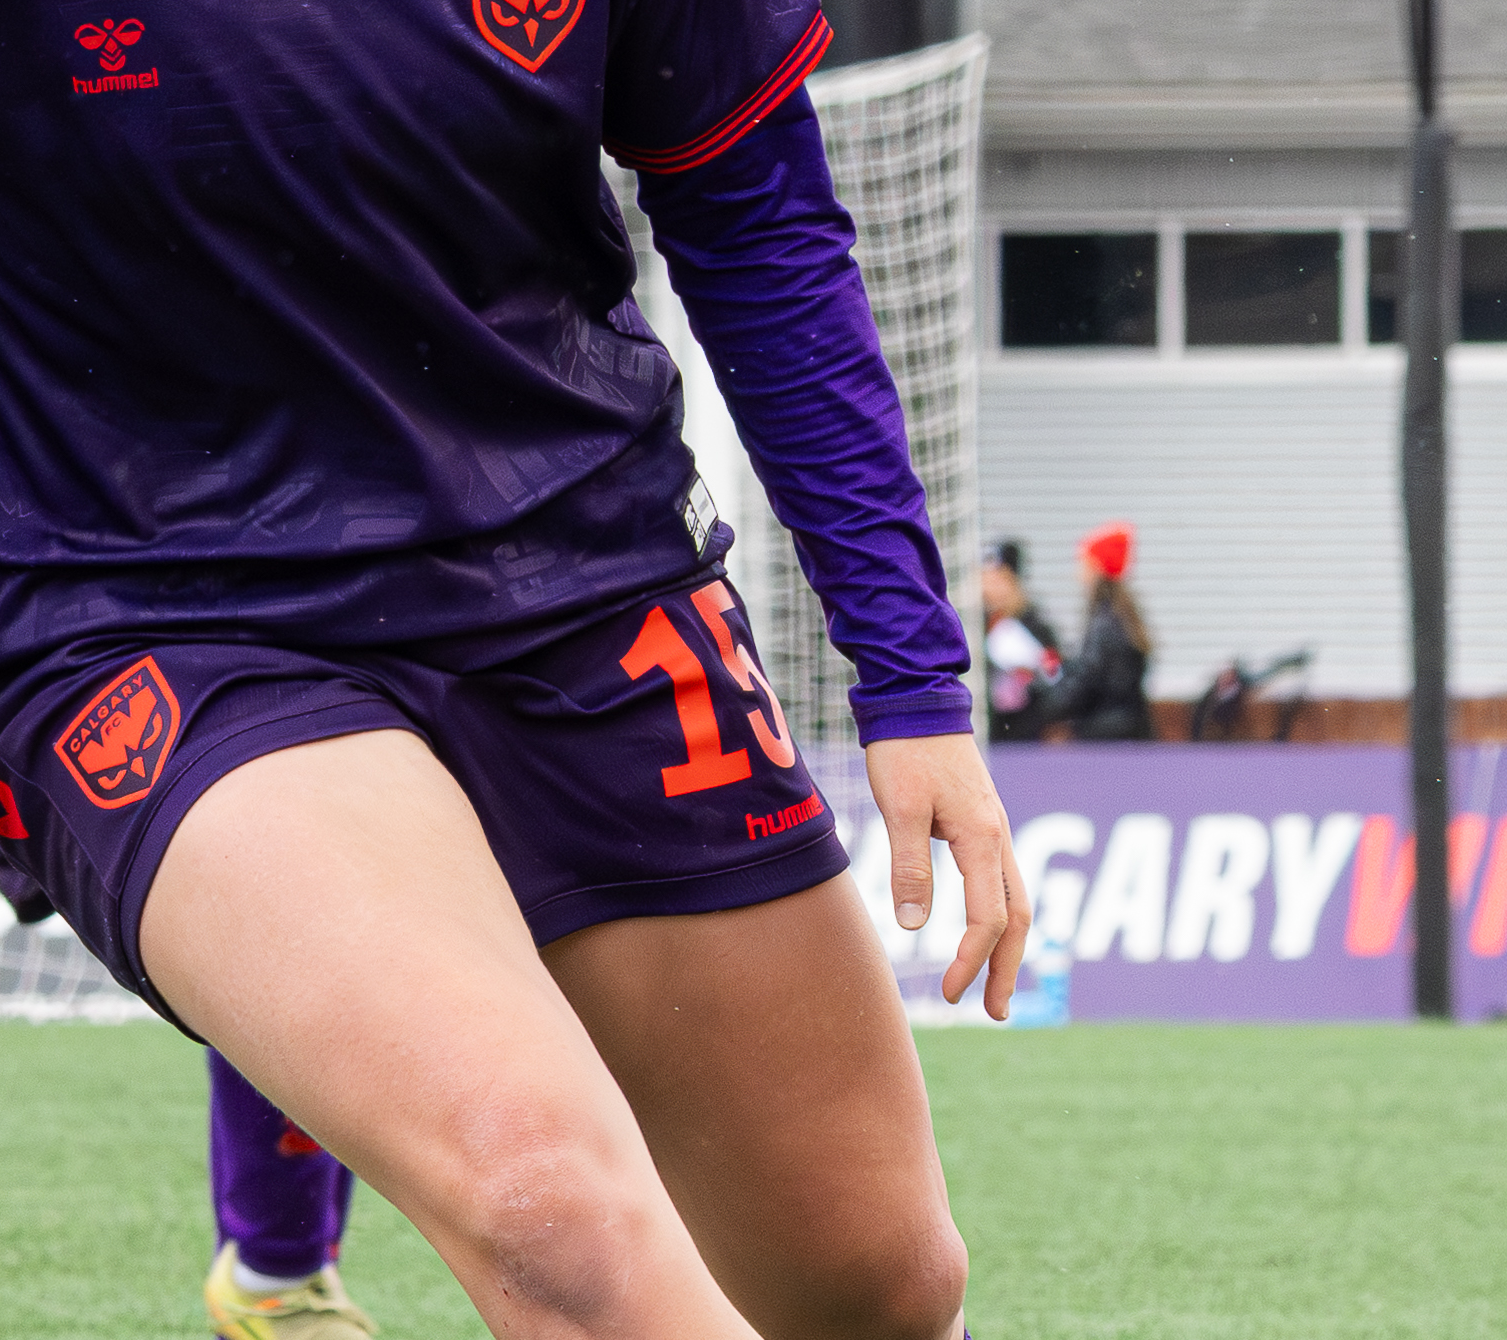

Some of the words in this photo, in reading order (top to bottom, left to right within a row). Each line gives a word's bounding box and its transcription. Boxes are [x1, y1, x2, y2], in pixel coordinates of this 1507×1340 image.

[72, 67, 160, 94] hummel
[70, 675, 143, 752] CALGARY
[619, 580, 795, 797] 15
[105, 717, 122, 736] FC
[745, 784, 824, 841] humme
